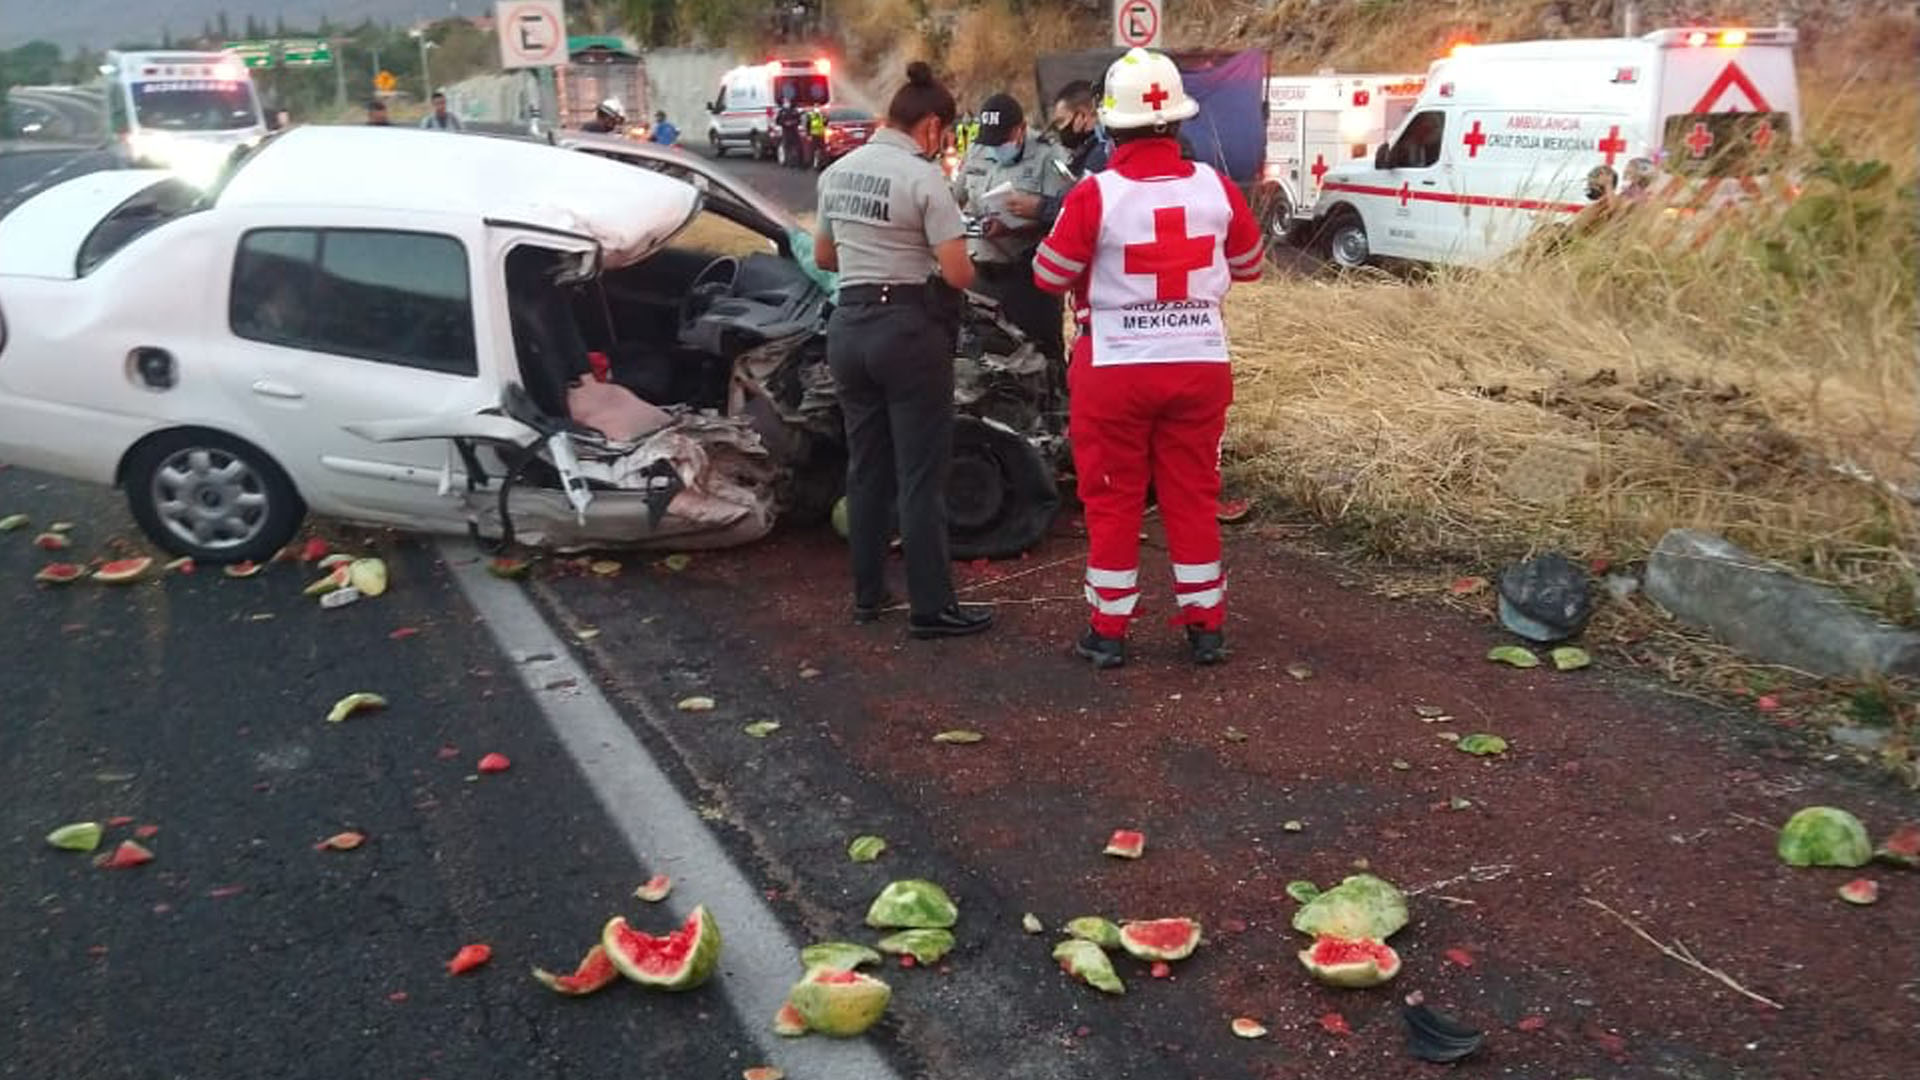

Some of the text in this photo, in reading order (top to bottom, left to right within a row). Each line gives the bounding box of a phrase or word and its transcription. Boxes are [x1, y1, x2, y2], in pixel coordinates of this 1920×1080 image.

[1506, 115, 1581, 130] AMBULANCIA
[1487, 134, 1596, 151] CRUZ ROJA MEXICANA
[1122, 312, 1212, 330] MEXICANA
